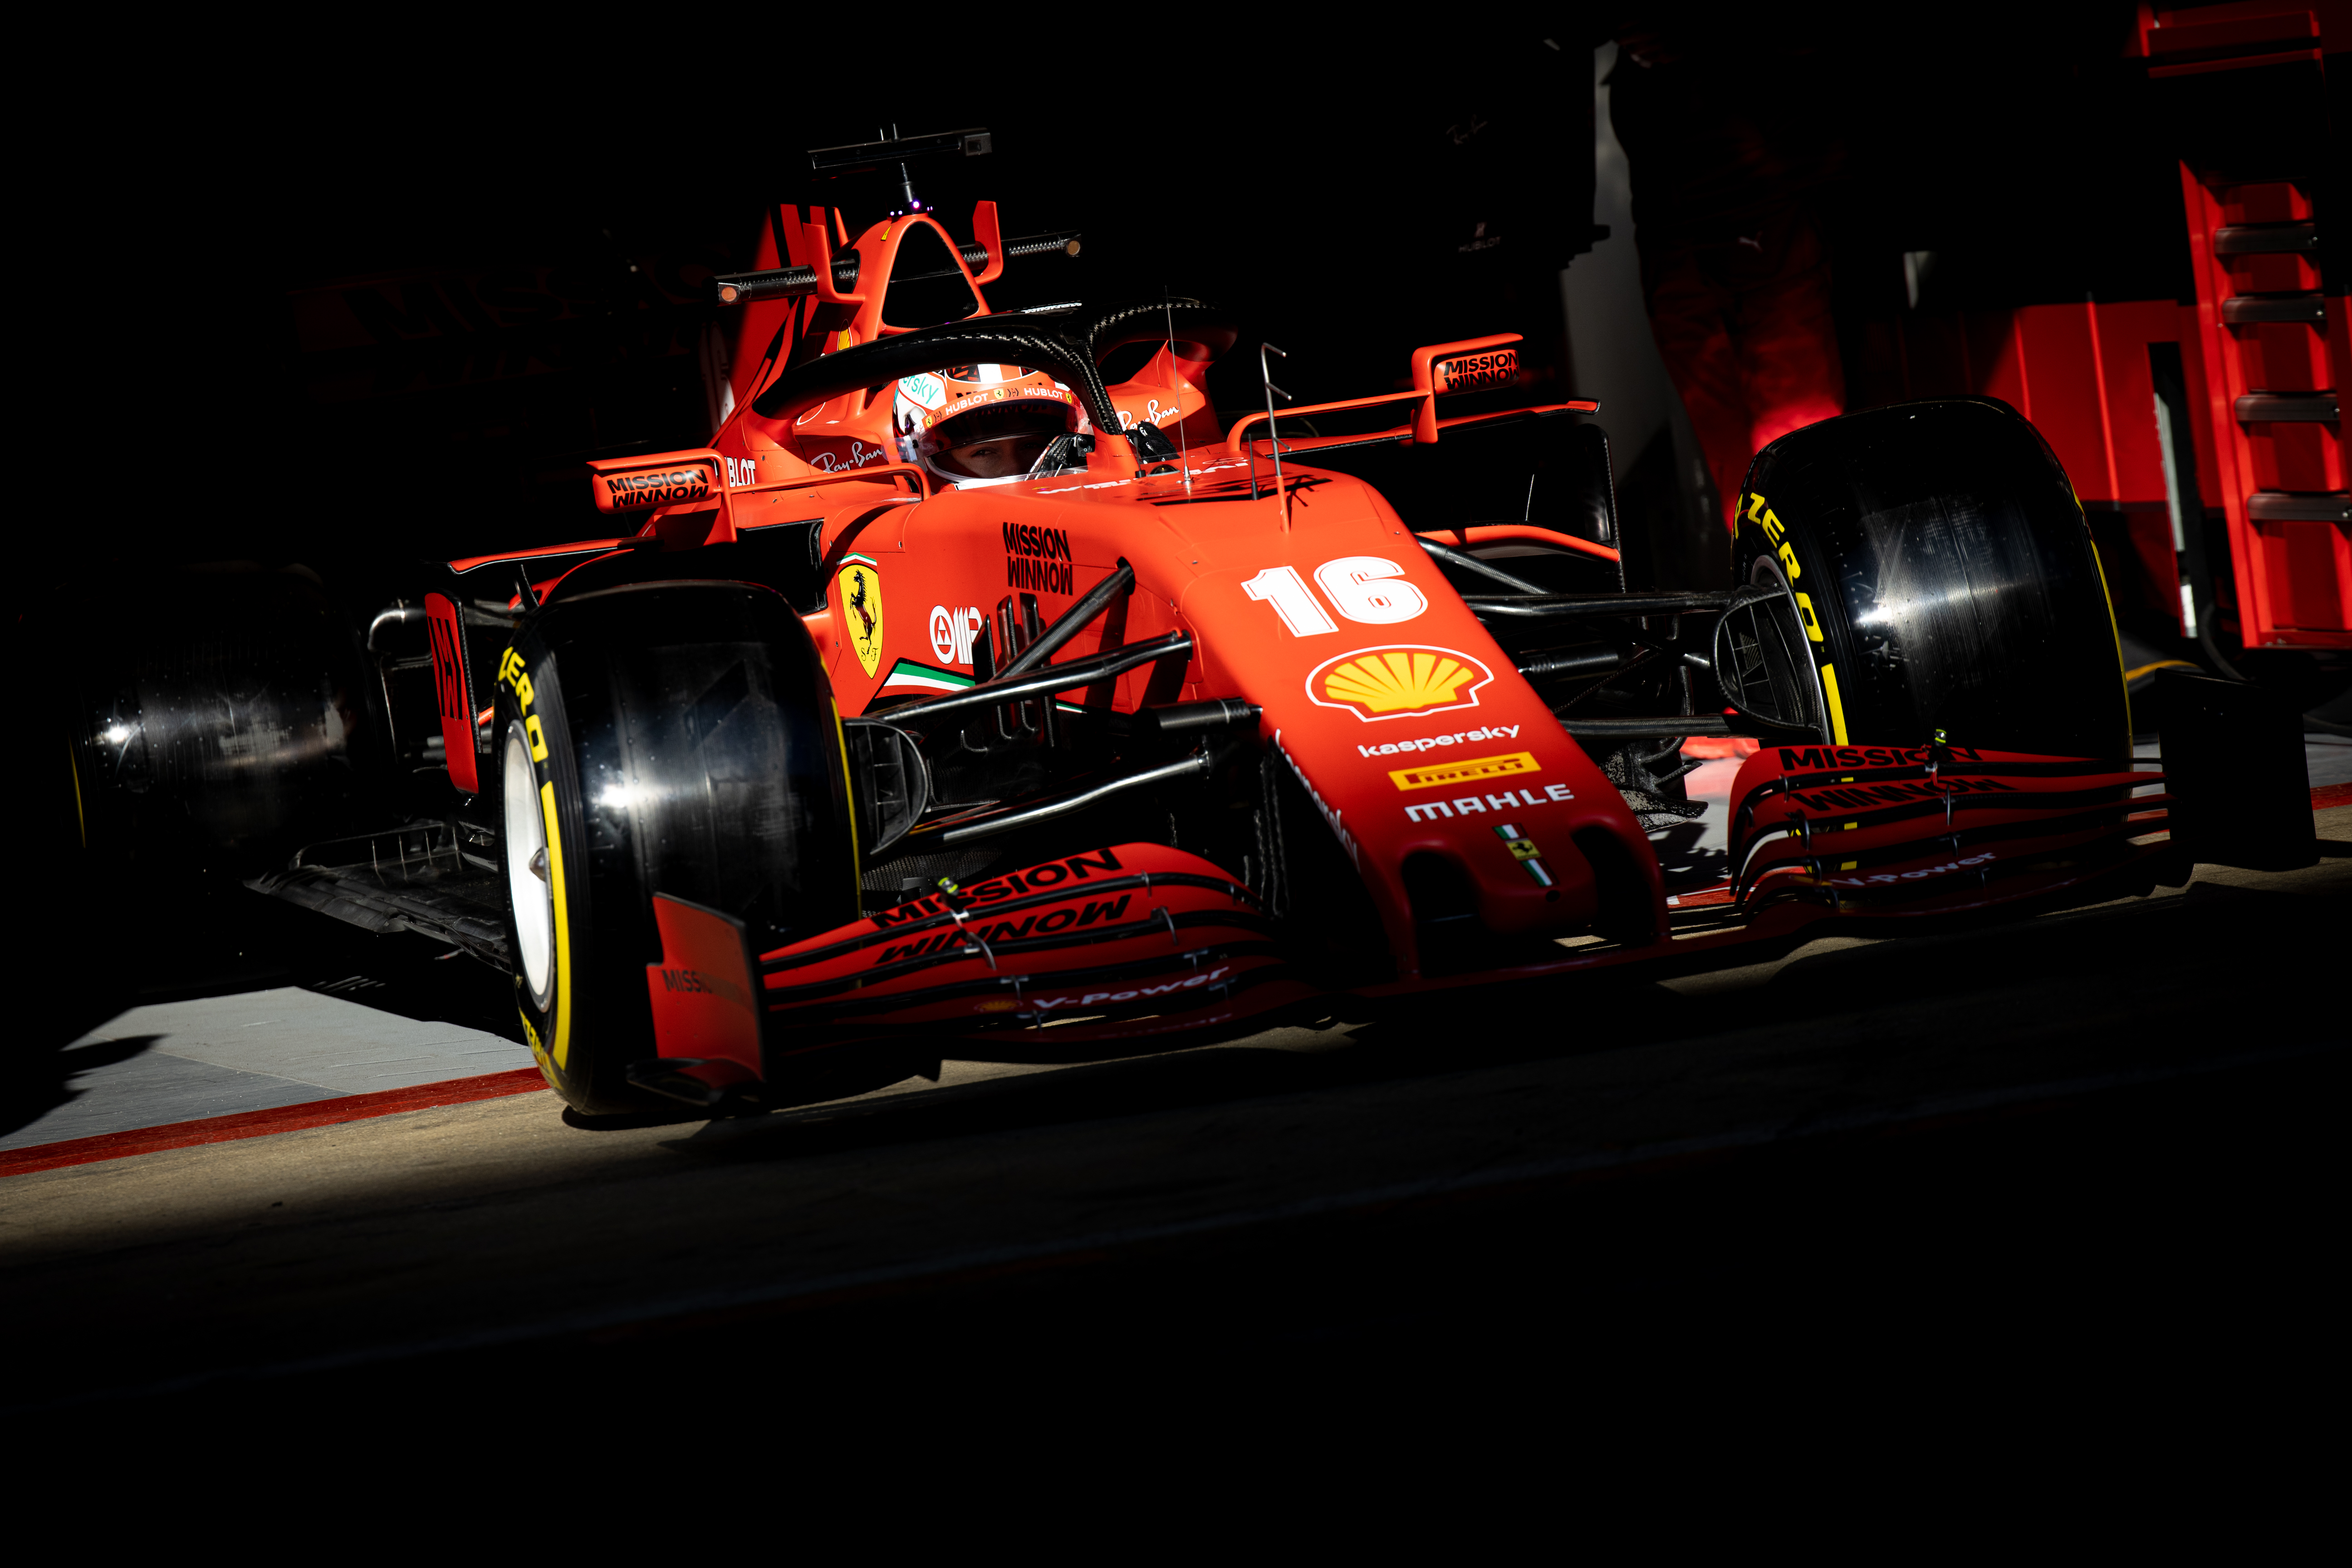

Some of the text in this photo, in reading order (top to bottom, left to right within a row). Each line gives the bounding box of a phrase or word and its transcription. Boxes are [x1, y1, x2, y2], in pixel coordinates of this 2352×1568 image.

[1458, 236, 1502, 254] HUBLOT
[1443, 351, 1518, 376] MISSION
[1443, 368, 1519, 390] WINNOW
[946, 392, 988, 416] HUBLOT
[1024, 387, 1063, 399] HUBLOT
[811, 441, 883, 474] Ray-Ban
[607, 469, 708, 495] MISSION
[612, 485, 709, 509] WINNOW
[1003, 522, 1072, 562] MISSION
[1007, 556, 1073, 596] WINNOW
[1748, 492, 1824, 643] ZERO
[1241, 556, 1428, 637] 16
[498, 646, 549, 763] ZERO
[1357, 725, 1520, 758] kaspersky
[1406, 758, 1524, 784] PIRELLI
[1404, 783, 1575, 823] MAHLE
[1792, 779, 2017, 811] WINNOW
[1828, 852, 1997, 887] V-Power
[876, 895, 1132, 963] WINNOW
[1033, 965, 1230, 1009] V-Power
